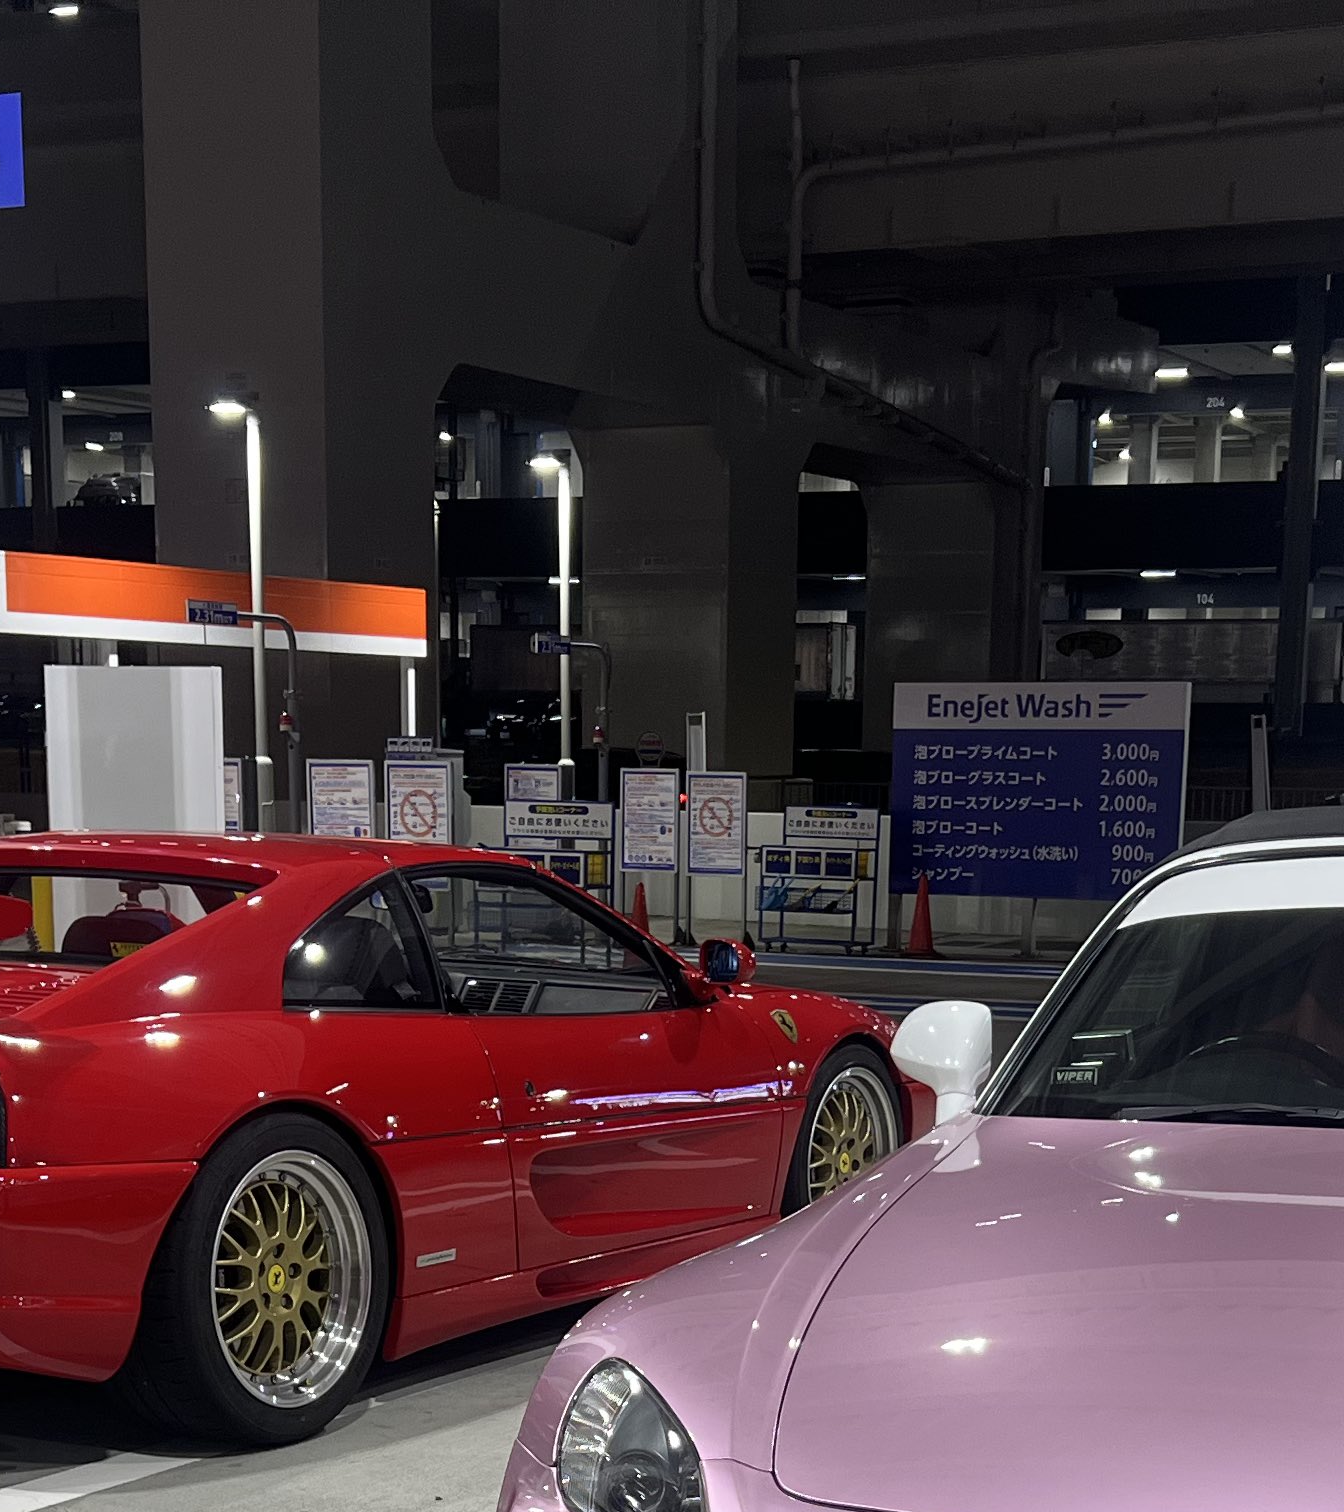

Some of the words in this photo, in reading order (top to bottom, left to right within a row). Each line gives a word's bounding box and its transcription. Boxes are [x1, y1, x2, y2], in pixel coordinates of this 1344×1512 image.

[1197, 593, 1214, 605] 104
[1016, 693, 1092, 719] Wash
[913, 744, 1058, 761] 泡ブロープライムコート
[1102, 742, 1160, 763] 3,000円
[913, 769, 1047, 786] 泡ブローグラスコート
[1100, 768, 1158, 788] 2,600円
[1099, 793, 1157, 813] 2,000円
[911, 819, 1004, 836] 泡ブローコート
[1099, 819, 1156, 839] 1,600円
[1111, 844, 1155, 863] 900円
[911, 866, 975, 881] シャンプー
[1056, 1071, 1094, 1081] VIPER
